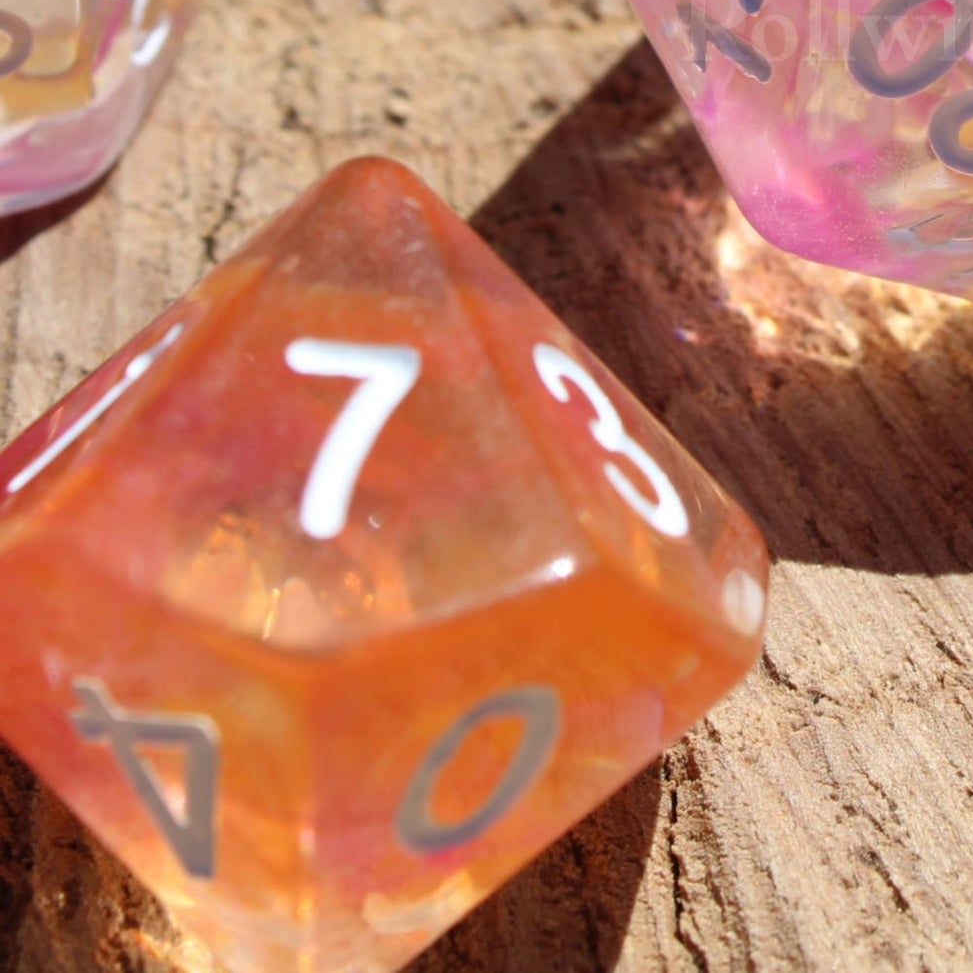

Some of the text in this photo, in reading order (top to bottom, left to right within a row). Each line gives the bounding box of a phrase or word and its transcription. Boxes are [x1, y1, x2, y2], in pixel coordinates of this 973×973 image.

[283, 336, 422, 540] 7
[532, 342, 689, 539] 3
[67, 674, 222, 881] 4
[393, 683, 566, 856] 0
